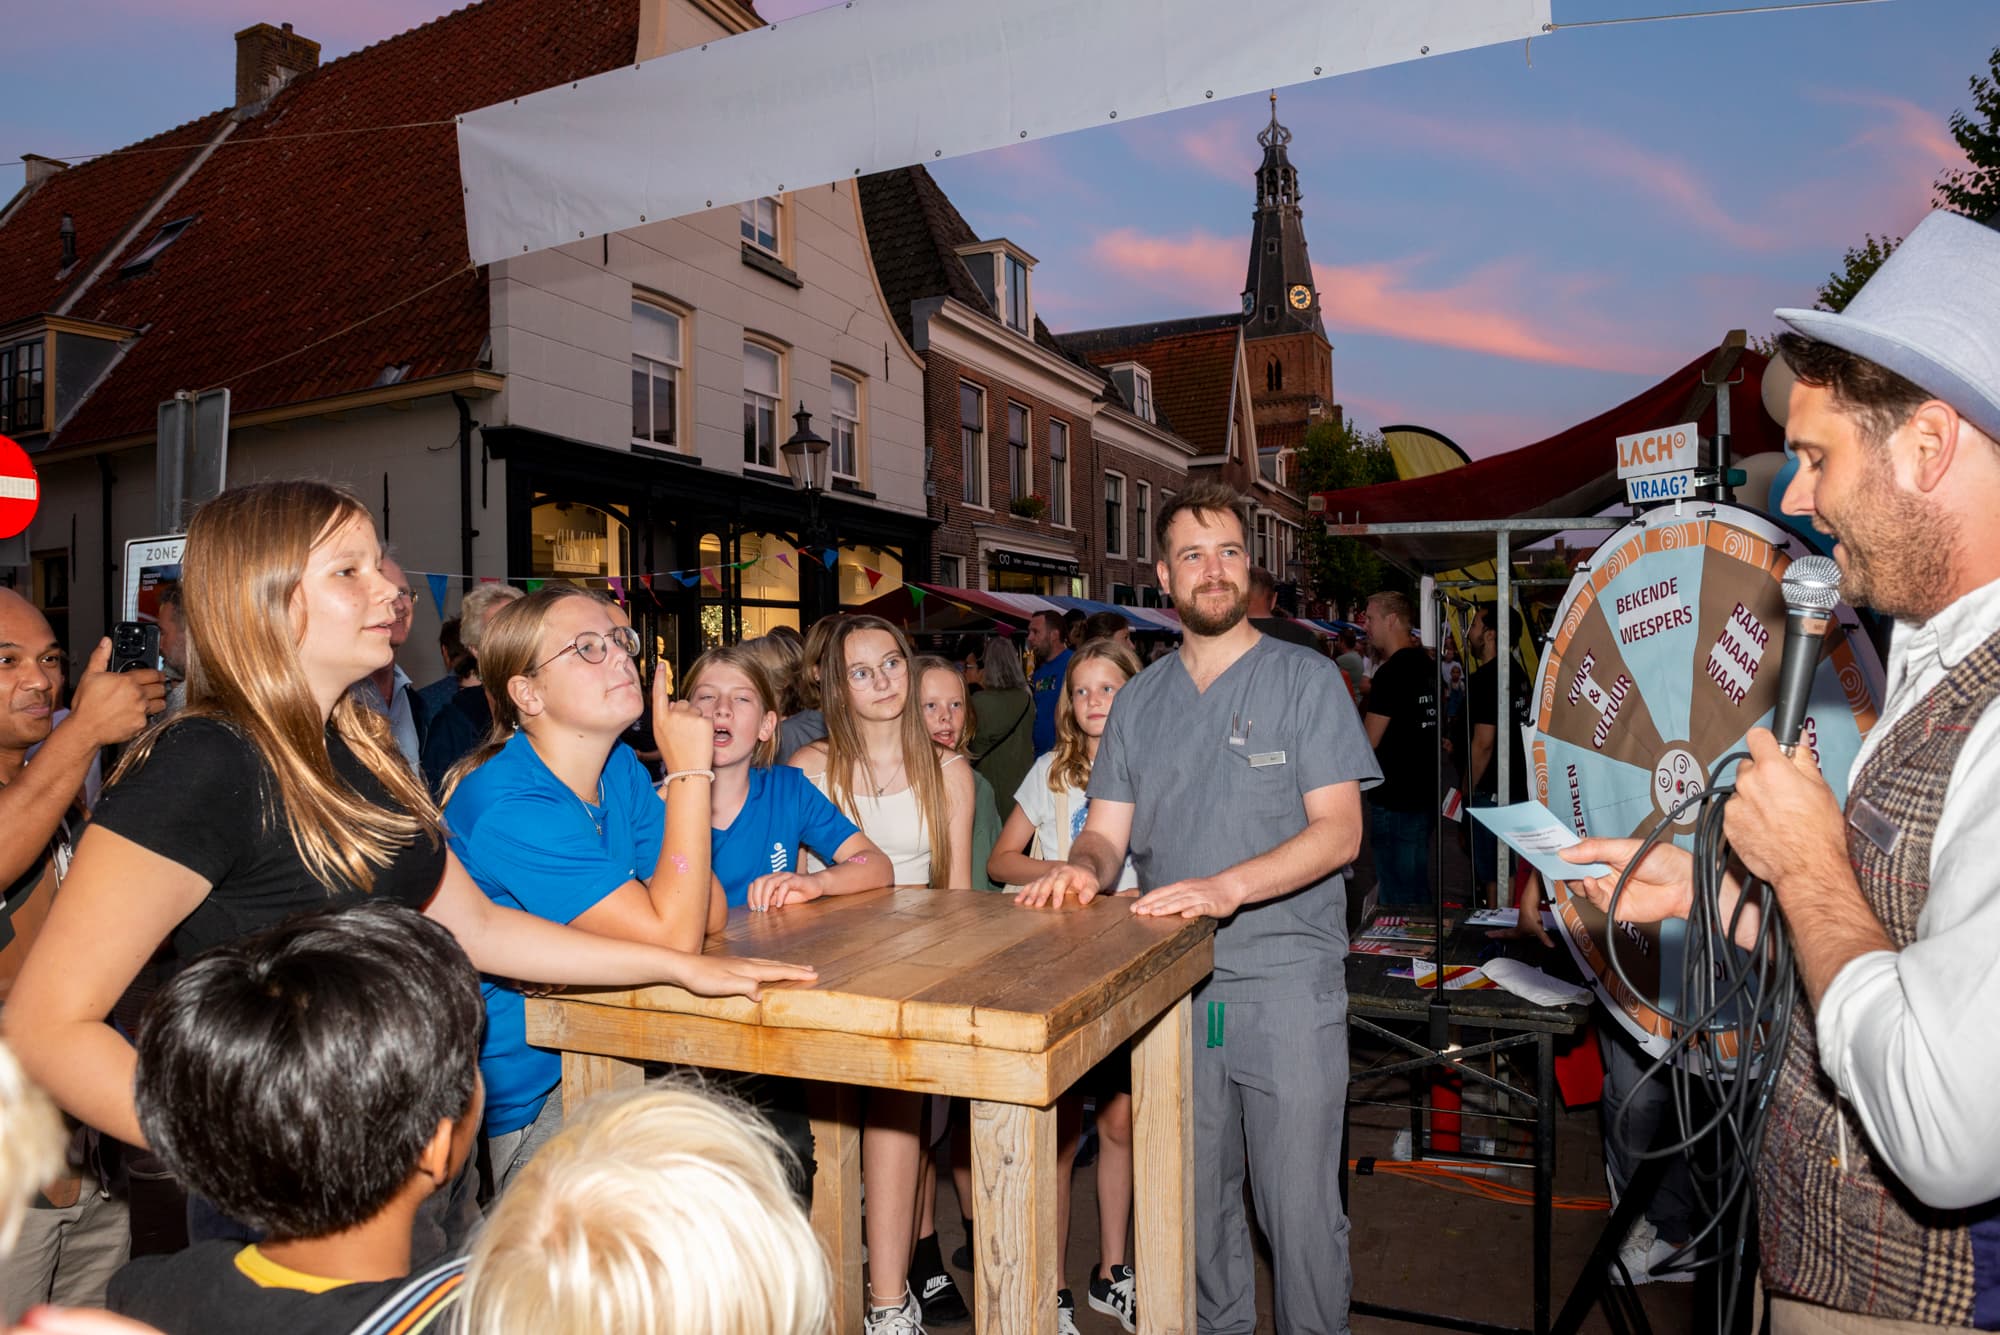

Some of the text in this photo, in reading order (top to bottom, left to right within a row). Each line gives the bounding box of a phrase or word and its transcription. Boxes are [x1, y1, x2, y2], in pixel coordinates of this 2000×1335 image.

[1619, 433, 1673, 467] LACH
[1631, 475, 1688, 500] VRAAG?
[146, 545, 178, 561] ZONE
[1616, 577, 1678, 615] BEKENDE
[1620, 605, 1692, 645] WEESPERS
[1731, 601, 1770, 650] RAAR
[1717, 629, 1760, 681] MAAR
[1567, 648, 1596, 707] KUNST
[1588, 688, 1602, 705] &
[1705, 654, 1746, 708] WAAR
[1592, 673, 1633, 750] CULTUUR
[1566, 764, 1588, 838] GEMEEN
[926, 1275, 949, 1290] NIKE
